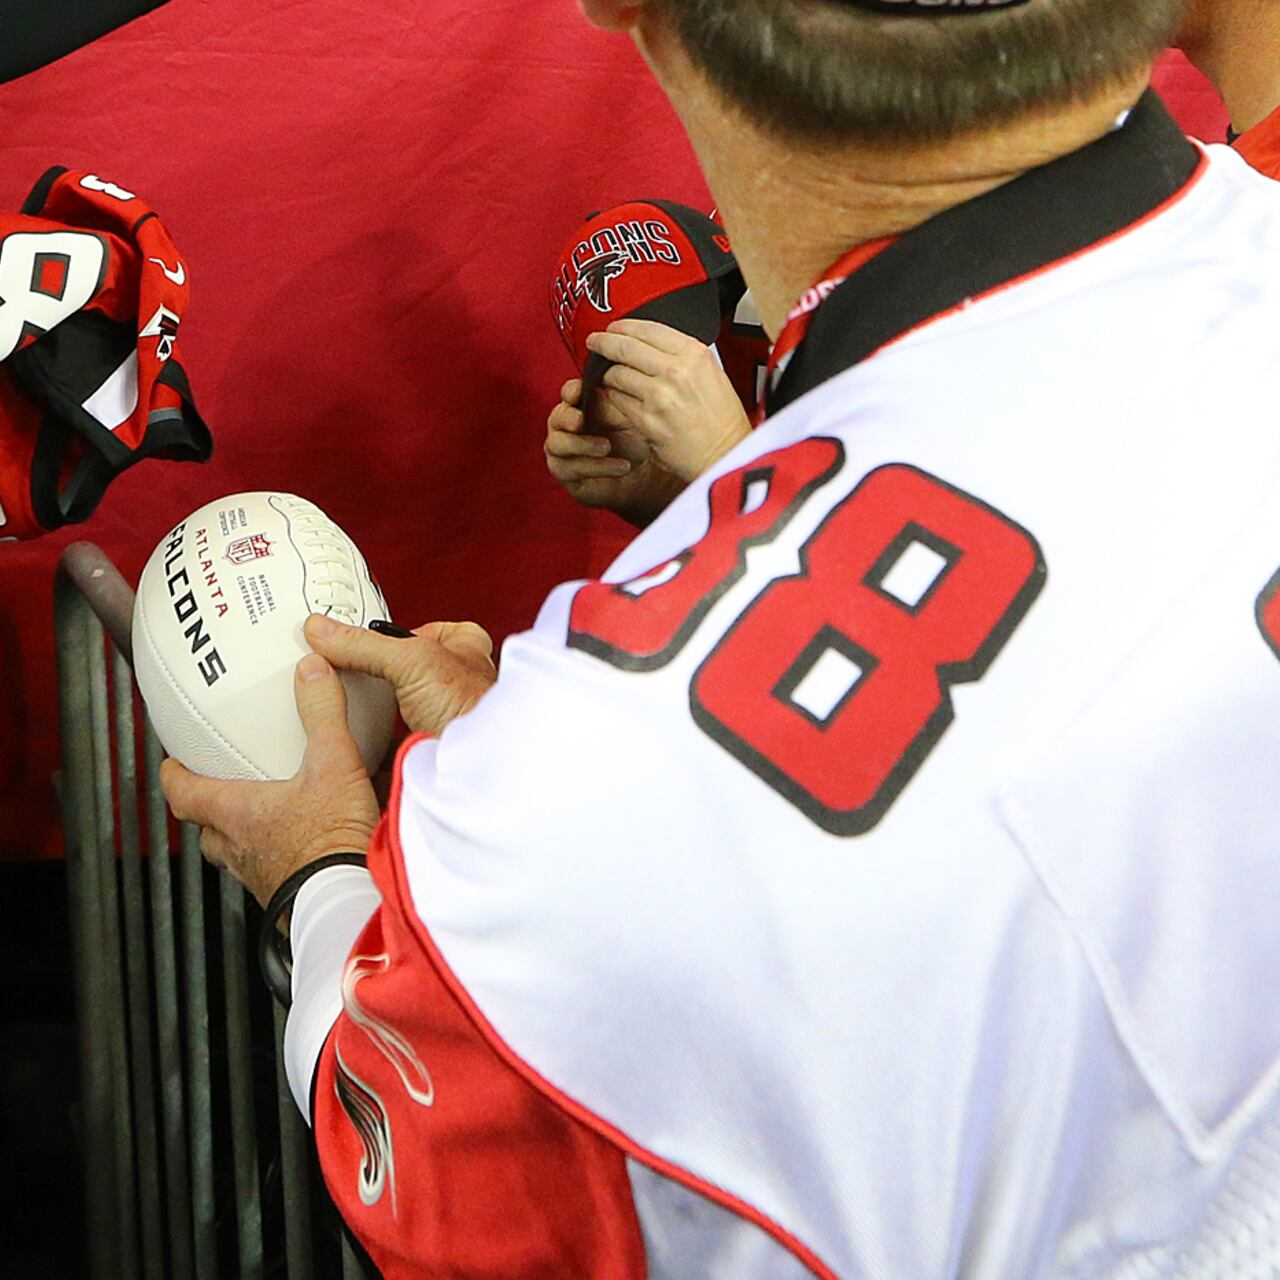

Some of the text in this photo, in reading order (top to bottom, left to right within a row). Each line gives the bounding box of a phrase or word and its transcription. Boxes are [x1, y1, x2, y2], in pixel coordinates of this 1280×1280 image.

[195, 528, 229, 618] ATLANTA
[231, 540, 255, 562] NFL
[165, 521, 227, 688] FALCONS
[236, 575, 259, 626] CONFERENCE
[247, 576, 267, 616] FOOTBALL
[257, 573, 277, 613] NATIONAL
[567, 435, 1048, 838] 88
